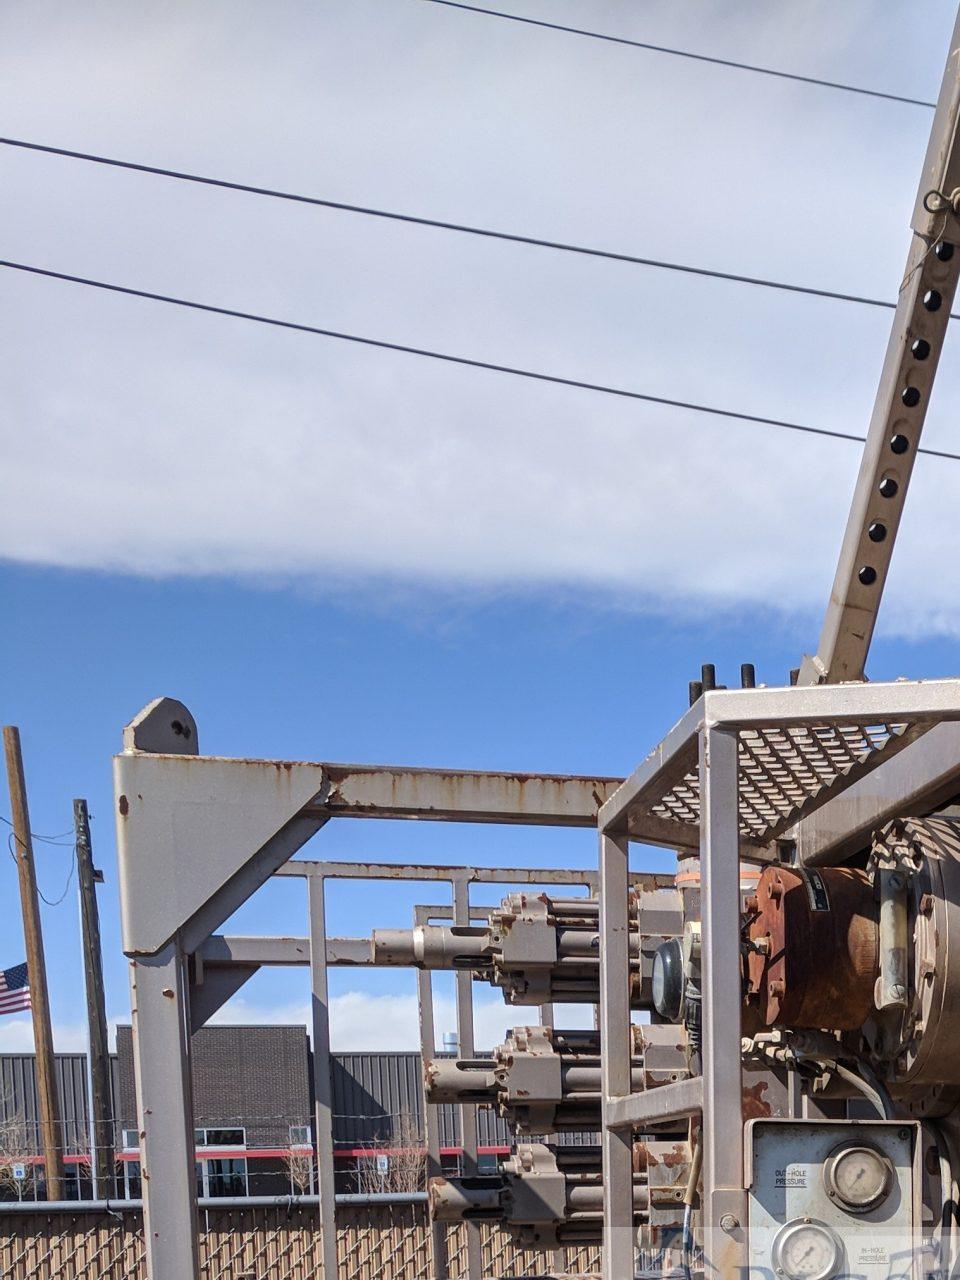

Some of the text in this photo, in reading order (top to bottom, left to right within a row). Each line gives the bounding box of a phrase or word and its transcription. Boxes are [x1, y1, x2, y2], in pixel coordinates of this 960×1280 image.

[775, 1169, 806, 1177] OUT-HOLE
[775, 1178, 806, 1186] PRESSURE
[858, 1254, 888, 1262] PRESSURE
